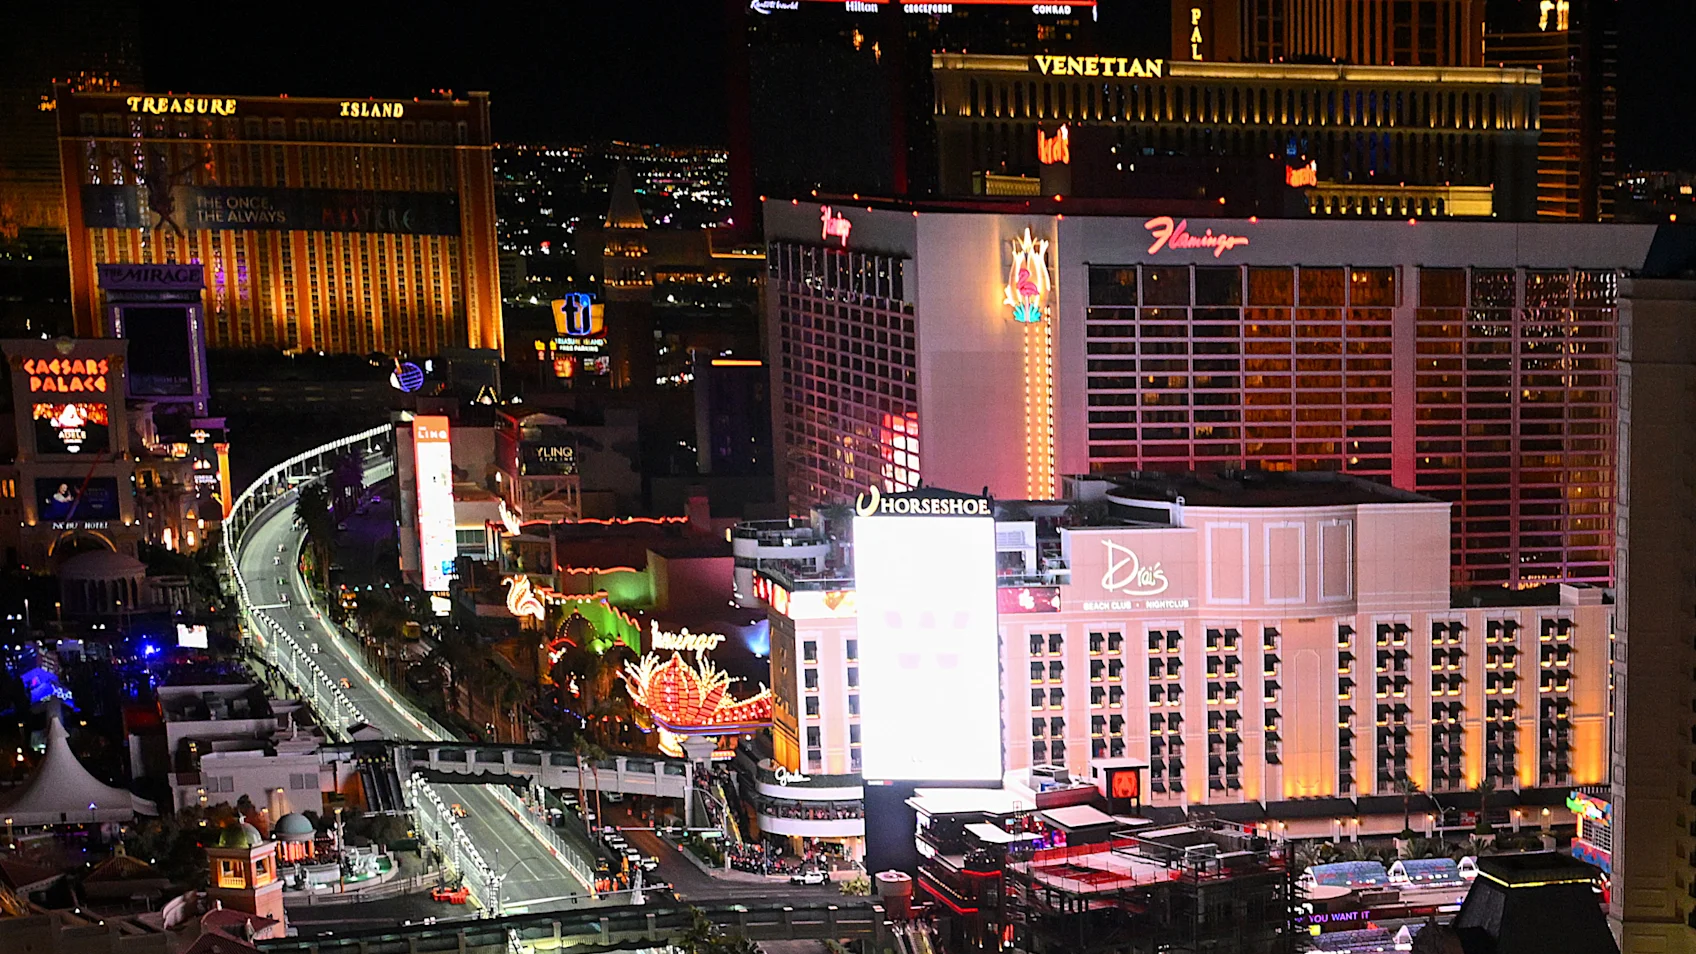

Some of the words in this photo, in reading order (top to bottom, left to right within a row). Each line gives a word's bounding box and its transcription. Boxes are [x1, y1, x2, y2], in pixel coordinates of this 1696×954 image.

[845, 1, 878, 12] Hilton
[1032, 5, 1071, 14] CONRAD
[1034, 55, 1163, 78] VENETIAN
[126, 96, 237, 115] TREASURE
[340, 101, 404, 118] ISLAND
[197, 196, 222, 210] THE
[197, 209, 224, 223] THE
[228, 210, 286, 223] ALWAYS
[1144, 216, 1249, 258] Flamingo
[112, 268, 200, 284] MIRAGE
[23, 359, 109, 375] CAESARS
[30, 376, 107, 392] PALACE
[418, 431, 447, 439] LINQ
[880, 498, 991, 515] HORSESHOE
[1101, 539, 1168, 596] Drai's
[1083, 602, 1110, 611] BEACH
[1308, 914, 1329, 923] YOU
[1331, 912, 1358, 922] WANT
[1361, 911, 1371, 919] IT
